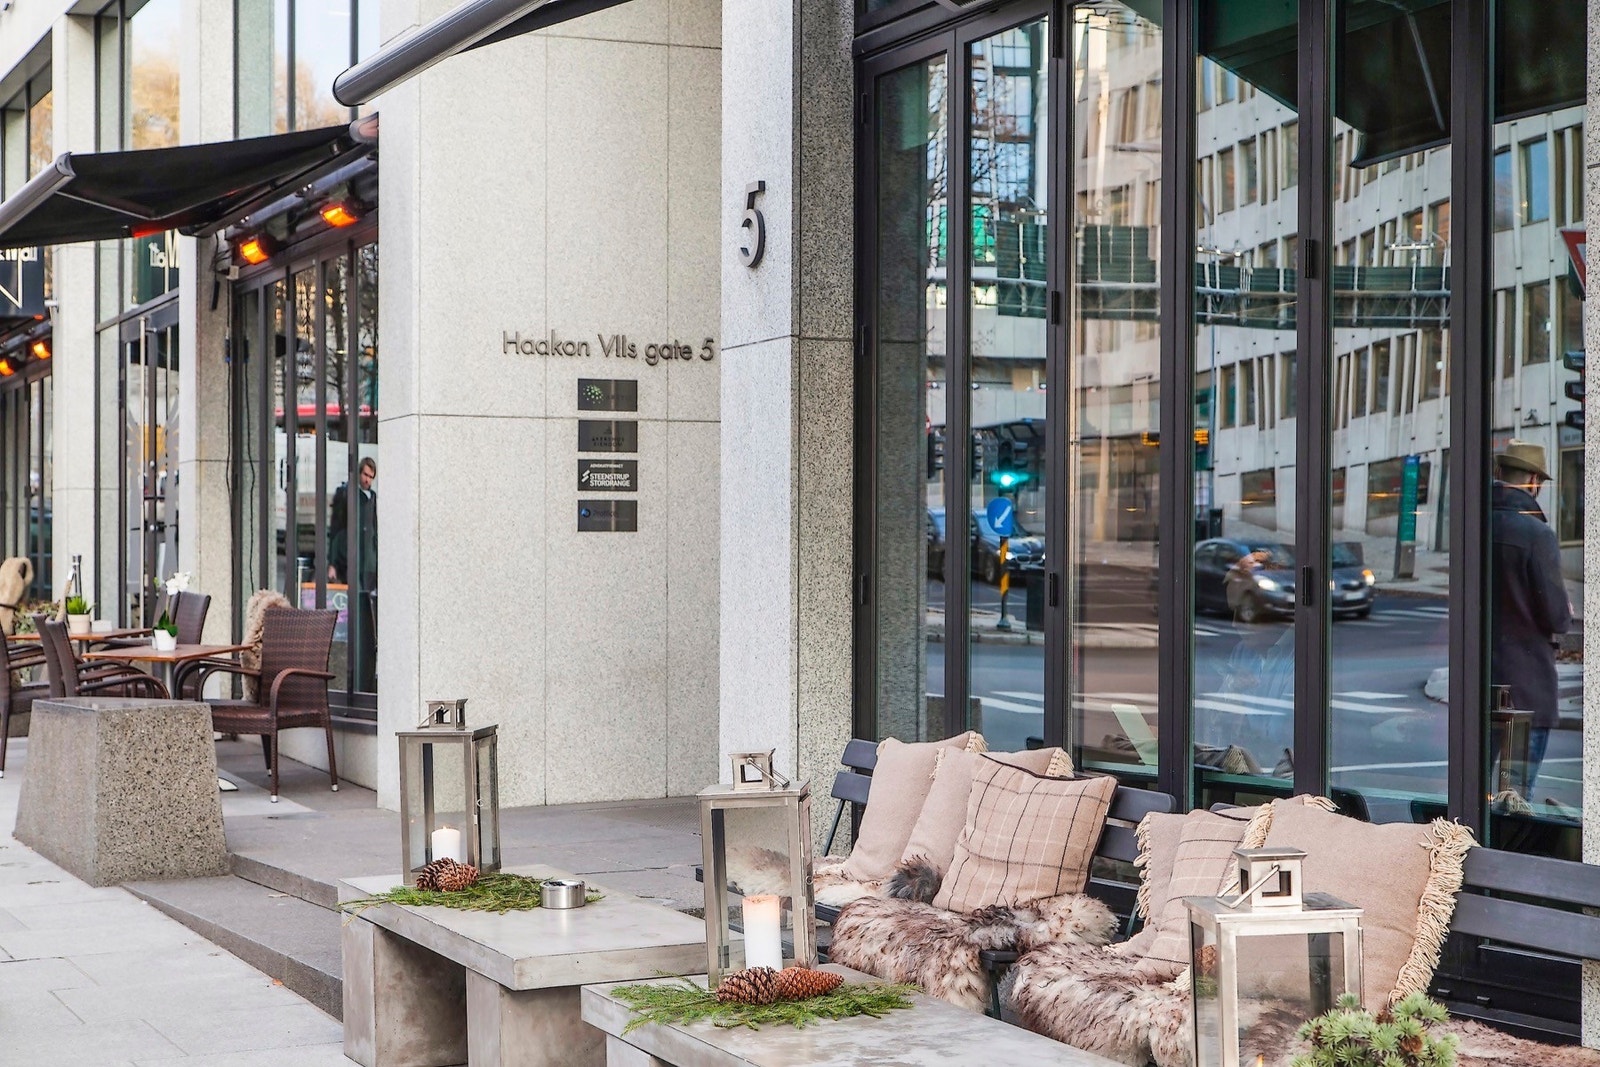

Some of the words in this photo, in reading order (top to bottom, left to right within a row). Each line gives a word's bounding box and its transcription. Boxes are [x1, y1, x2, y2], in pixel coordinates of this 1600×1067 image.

[738, 180, 766, 268] 5
[503, 329, 591, 357] Haakon
[644, 339, 693, 367] gate
[699, 337, 715, 362] 5
